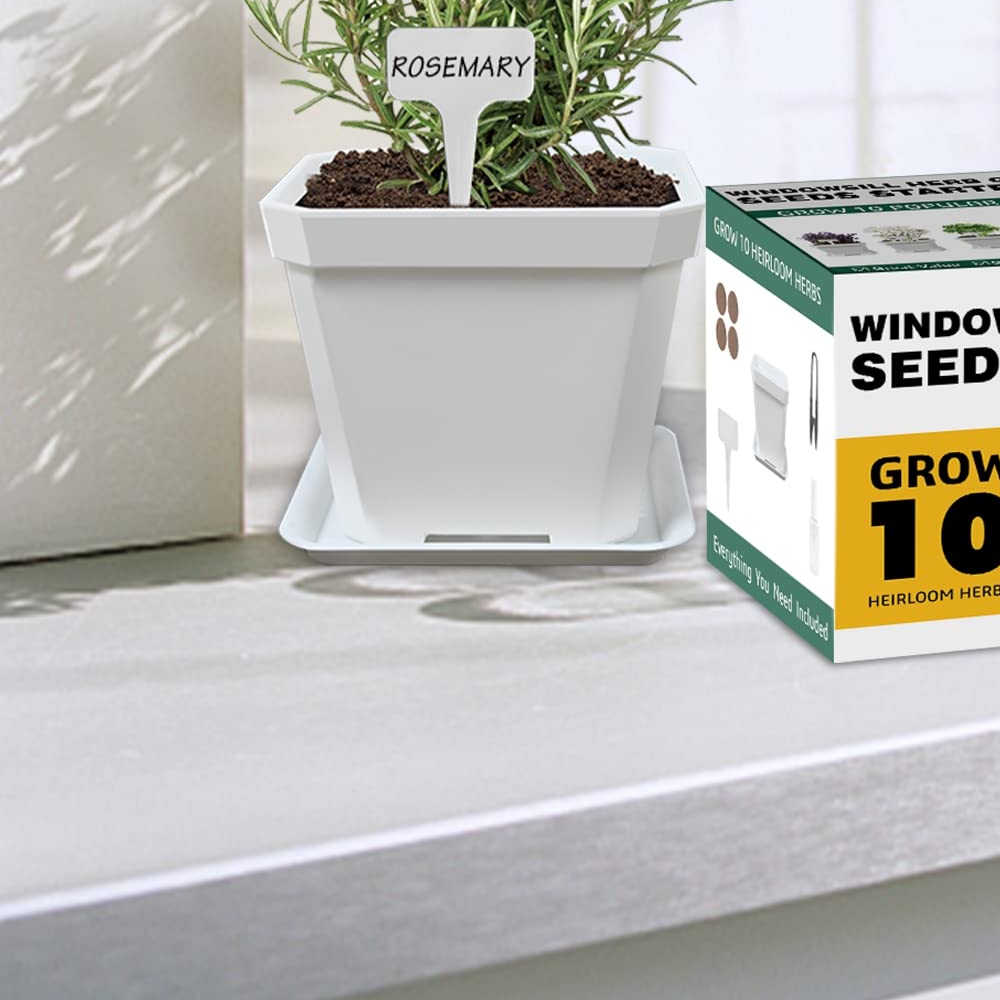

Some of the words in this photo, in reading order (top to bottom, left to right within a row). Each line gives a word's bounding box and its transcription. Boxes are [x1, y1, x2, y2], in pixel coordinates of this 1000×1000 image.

[391, 55, 531, 78] ROSEMARY
[725, 182, 902, 197] WINDOWSILL
[905, 177, 981, 188] HERB
[736, 191, 860, 205] SEEDS
[714, 216, 738, 247] GROW
[740, 234, 750, 255] 10
[751, 242, 793, 286] HEIRLOOM
[794, 272, 822, 305] HERBS
[713, 534, 752, 584] Everything
[755, 567, 770, 594] You
[773, 582, 793, 612] Need
[796, 601, 828, 641] Included
[868, 588, 954, 608] HEIRLOOM
